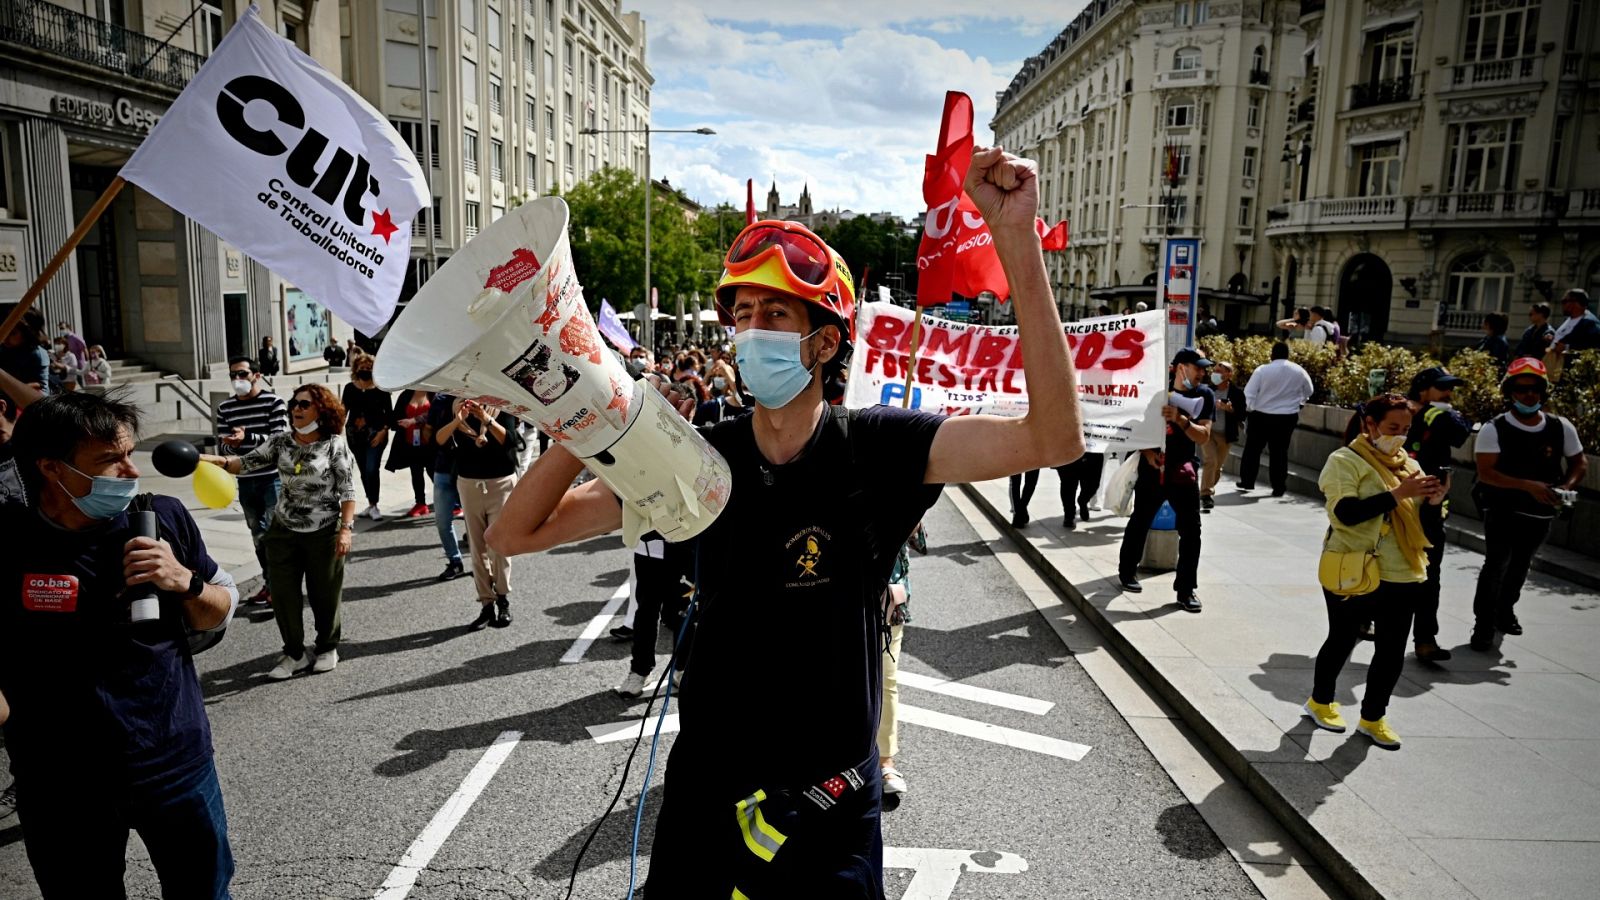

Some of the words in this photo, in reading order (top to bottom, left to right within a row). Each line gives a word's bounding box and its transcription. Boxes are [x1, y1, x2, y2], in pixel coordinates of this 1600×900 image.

[53, 95, 115, 122] EDIFICIO
[257, 191, 279, 210] de
[280, 204, 375, 279] Traballadoras
[268, 178, 331, 229] Central
[329, 221, 385, 266] Unitaria
[920, 315, 935, 326] NO
[937, 320, 949, 329] ES
[951, 323, 965, 332] UNA
[998, 327, 1011, 336] ES
[1064, 318, 1137, 334] ENCUBIERTO
[866, 314, 1147, 371] BOMBOS
[572, 412, 598, 432] Roja
[29, 577, 71, 588] co.bas
